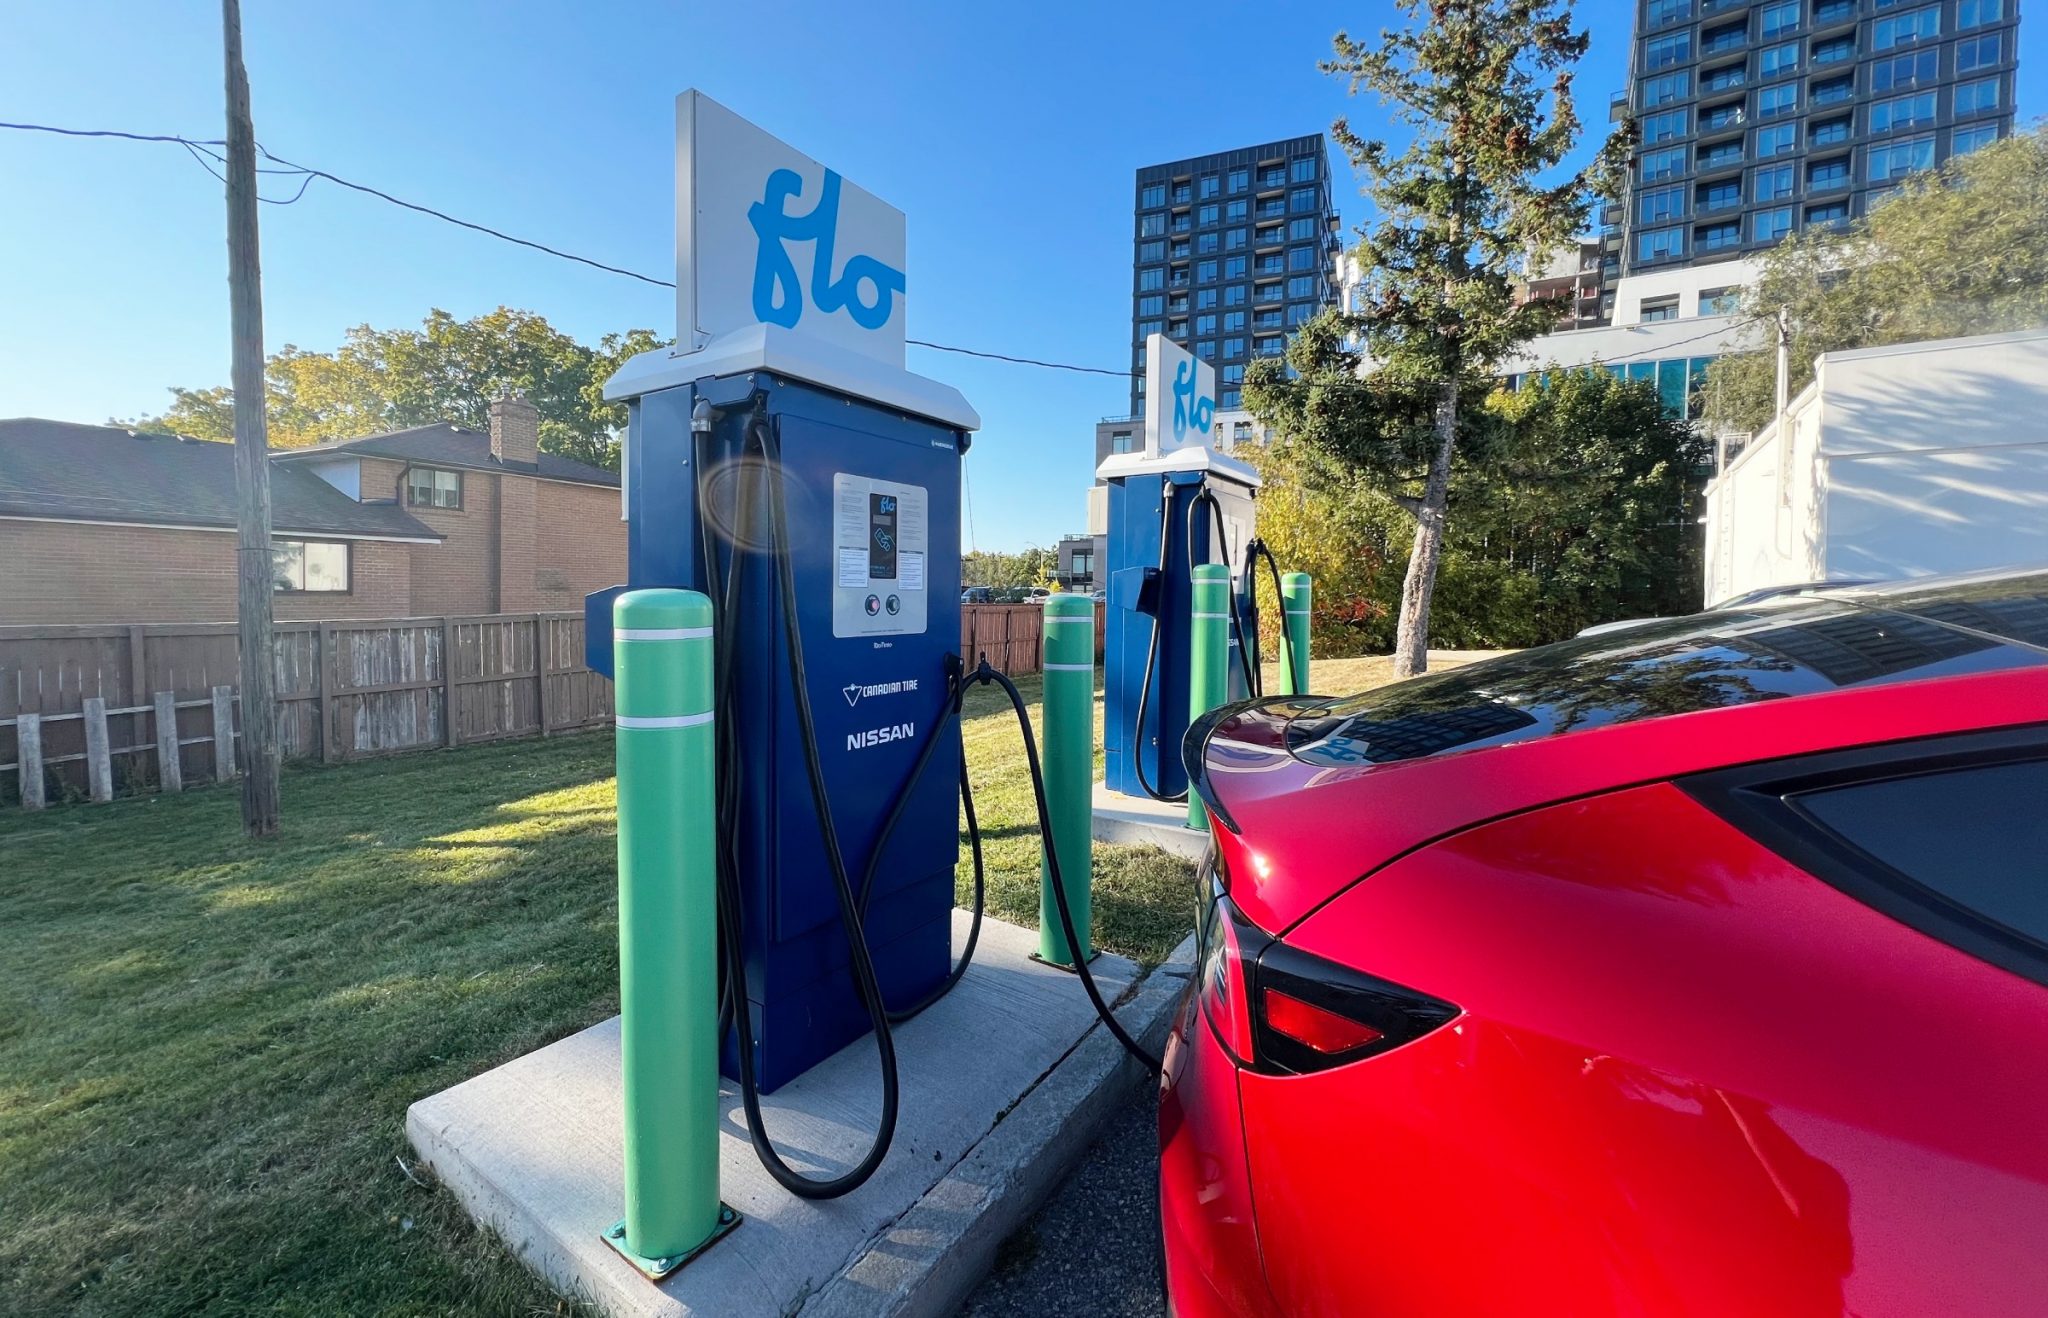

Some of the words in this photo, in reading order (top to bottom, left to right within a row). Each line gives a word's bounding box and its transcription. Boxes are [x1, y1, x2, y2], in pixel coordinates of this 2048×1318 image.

[747, 167, 906, 330] flo
[1173, 357, 1216, 443] flo
[880, 497, 897, 514] flo
[863, 682, 901, 698] CANADIAN
[902, 680, 918, 692] TIRE
[847, 722, 914, 751] NISSAN
